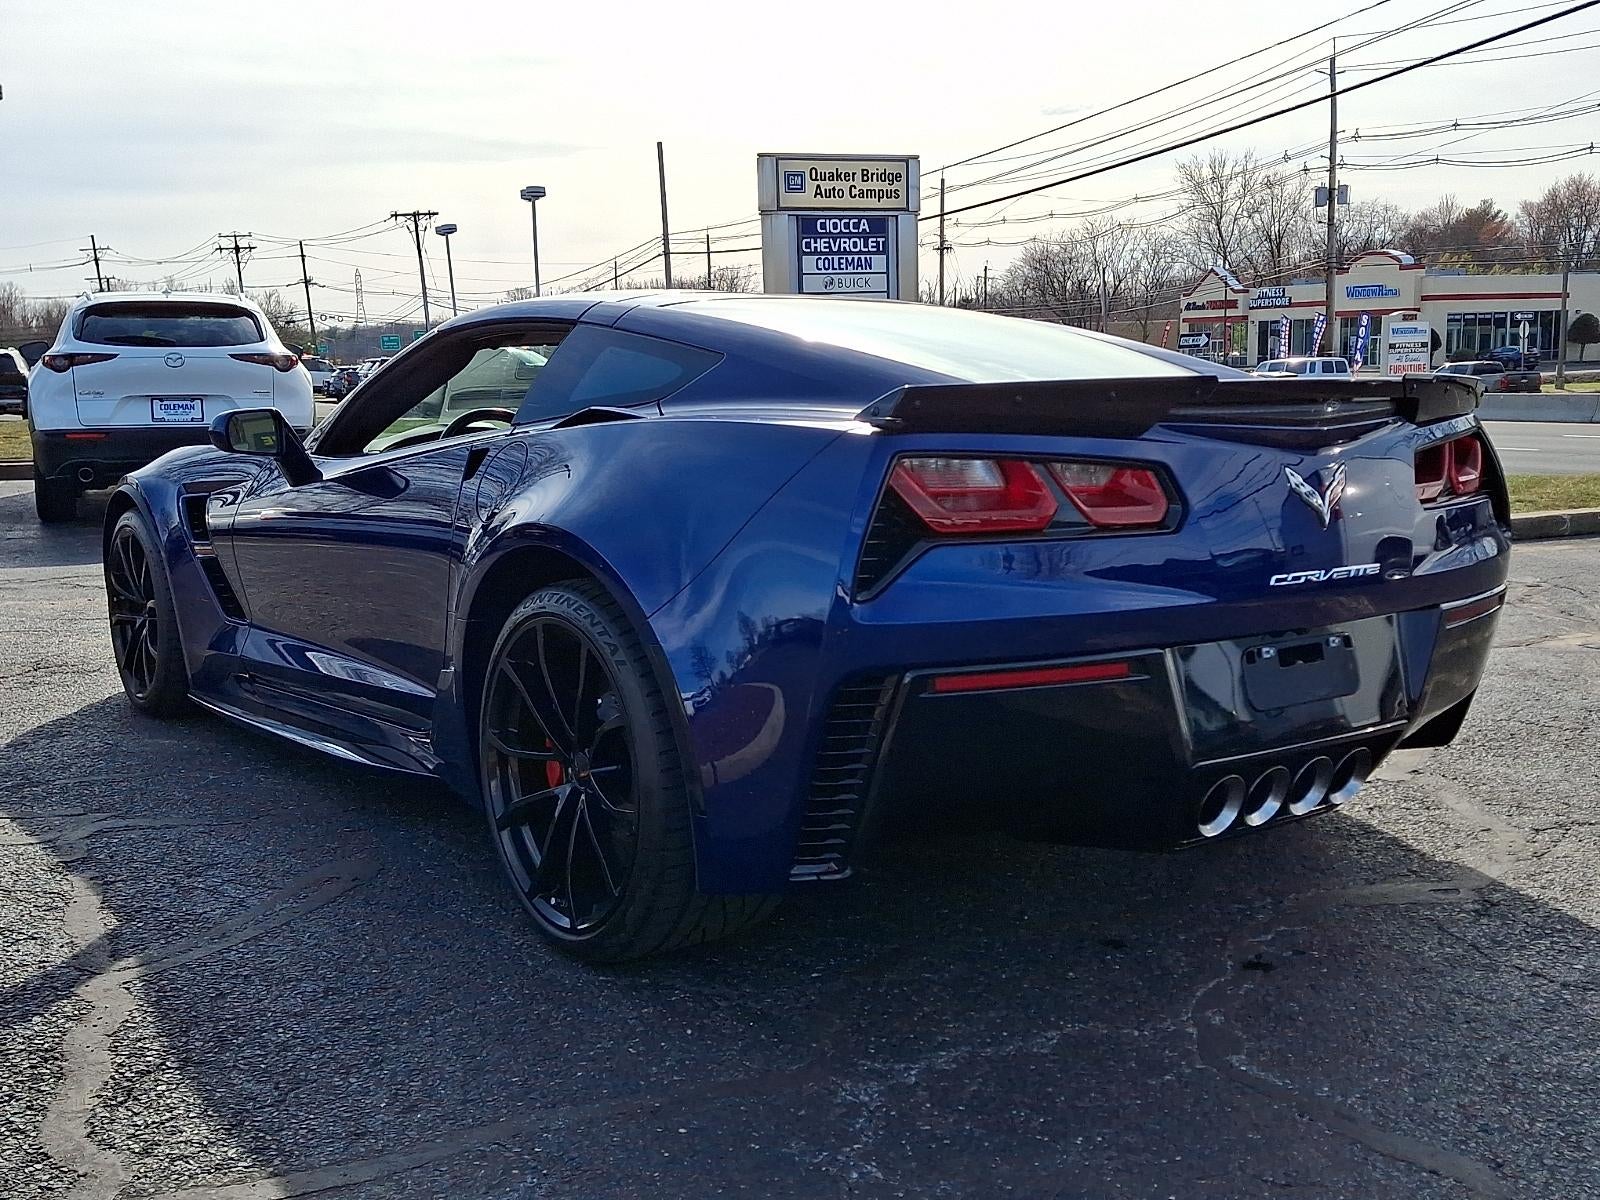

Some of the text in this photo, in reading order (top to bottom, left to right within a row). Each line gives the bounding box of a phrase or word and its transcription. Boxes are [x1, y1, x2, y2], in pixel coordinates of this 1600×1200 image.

[789, 175, 801, 185] GM
[809, 167, 903, 185] Quaker Bridge
[813, 184, 901, 203] Auto Campus
[816, 218, 870, 233] CIOCCA
[801, 237, 886, 252] CHEVROLET
[815, 256, 873, 271] COLEMAN
[837, 277, 872, 289] BUICK
[1257, 287, 1284, 298] FITNESS
[1249, 297, 1290, 308] SUPERSTORE
[1389, 363, 1427, 374] FURNITURE
[159, 403, 196, 411] COLEMAN
[1269, 563, 1381, 586] CORVETTE
[512, 590, 628, 673] CONTINENTAL
